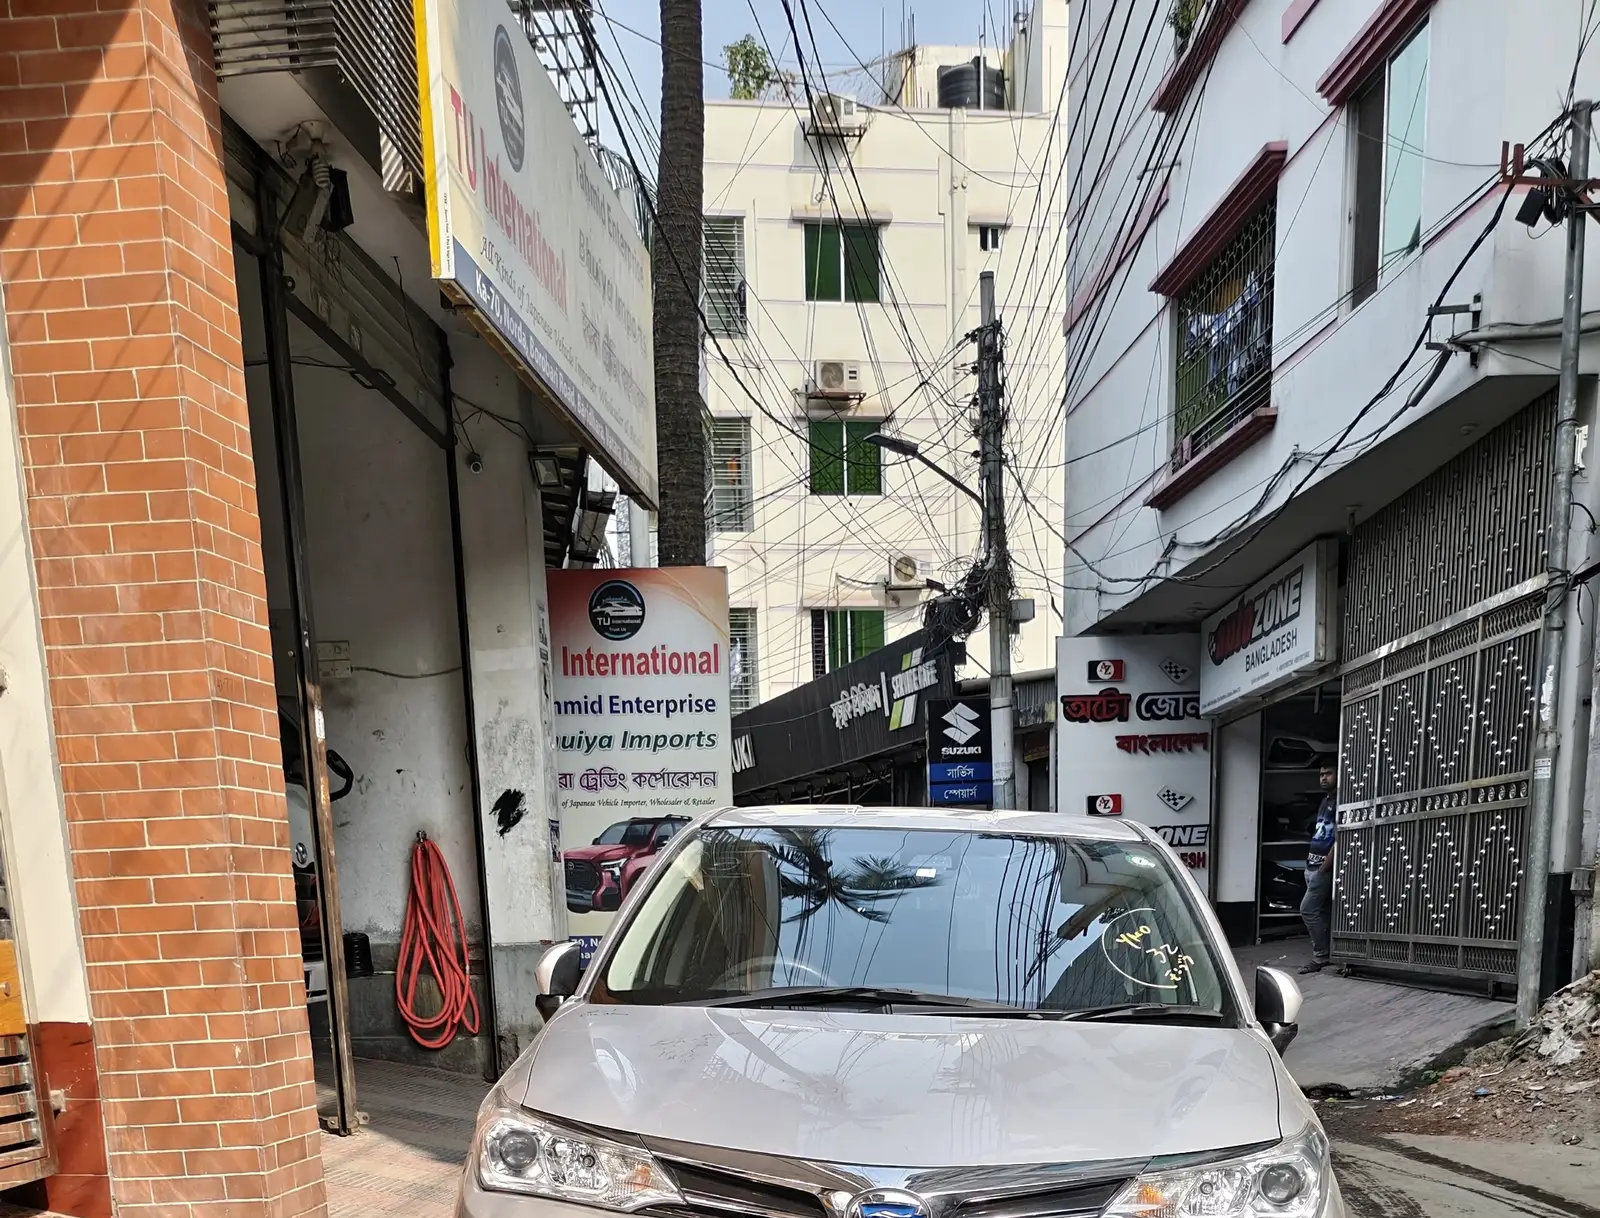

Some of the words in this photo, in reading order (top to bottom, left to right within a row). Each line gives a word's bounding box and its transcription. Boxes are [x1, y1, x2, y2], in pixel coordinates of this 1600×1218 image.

[450, 84, 477, 195] TU
[480, 125, 567, 317] International
[495, 253, 516, 291] Kinds
[475, 269, 502, 322] Ka-70,
[503, 303, 528, 357] Norda,
[597, 617, 611, 626] TU
[561, 643, 719, 676] International
[1245, 628, 1298, 673] BANGLADESH
[609, 694, 716, 718] Enterprise
[1061, 687, 1131, 722] অটো
[556, 730, 613, 753] uiya
[621, 730, 717, 752] Imports
[731, 734, 755, 773] UKI
[941, 746, 982, 755] SUZUKI
[579, 766, 627, 791] ট্রেডিং
[632, 768, 717, 788] কর্পোরেশন
[947, 764, 974, 779] সার্ভিস
[569, 799, 596, 809] Japanese
[597, 799, 619, 807] Vehicle
[620, 799, 648, 808] Importer,
[650, 798, 682, 806] Wholesaler
[692, 797, 716, 806] Retailer
[1149, 825, 1209, 847] ONE
